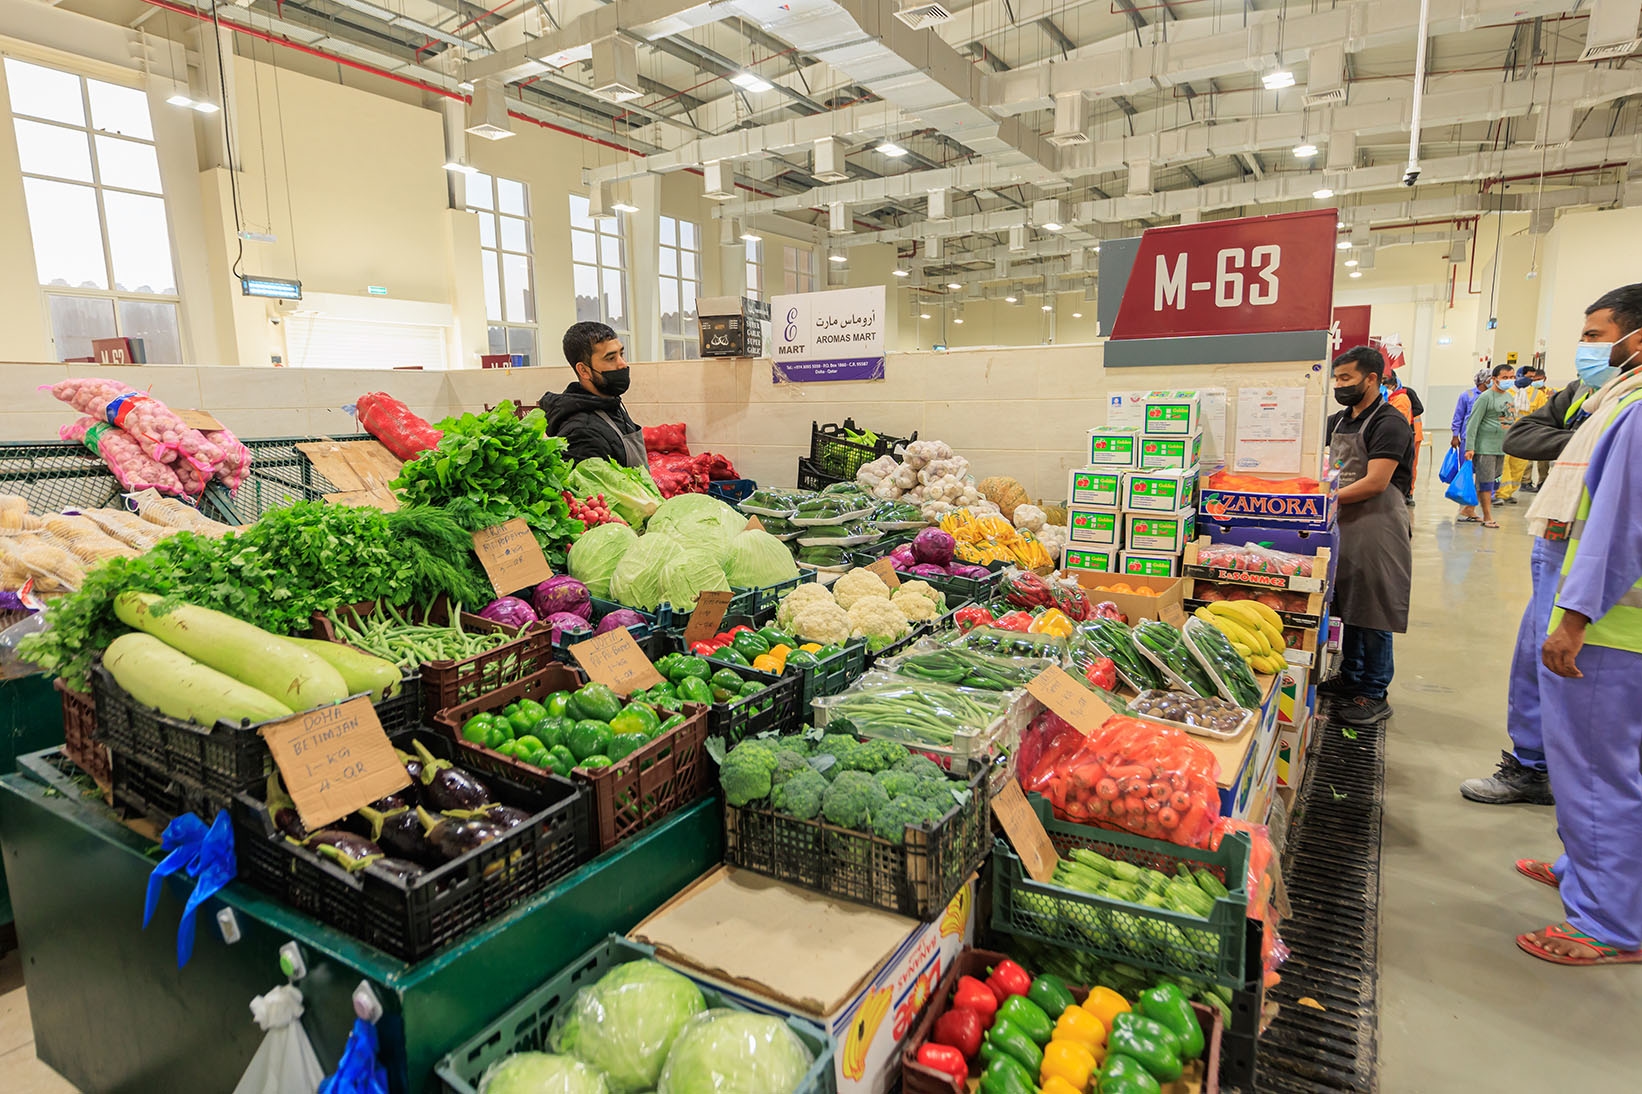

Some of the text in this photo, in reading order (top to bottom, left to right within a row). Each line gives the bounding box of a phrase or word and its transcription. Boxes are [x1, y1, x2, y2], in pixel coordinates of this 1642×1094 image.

[1154, 245, 1281, 311] M-63
[815, 309, 876, 329] أروماس مارت
[816, 332, 877, 344] AROMAS MART
[778, 345, 806, 354] MART
[1222, 495, 1318, 515] ZAMORA
[303, 708, 342, 731] DOHA
